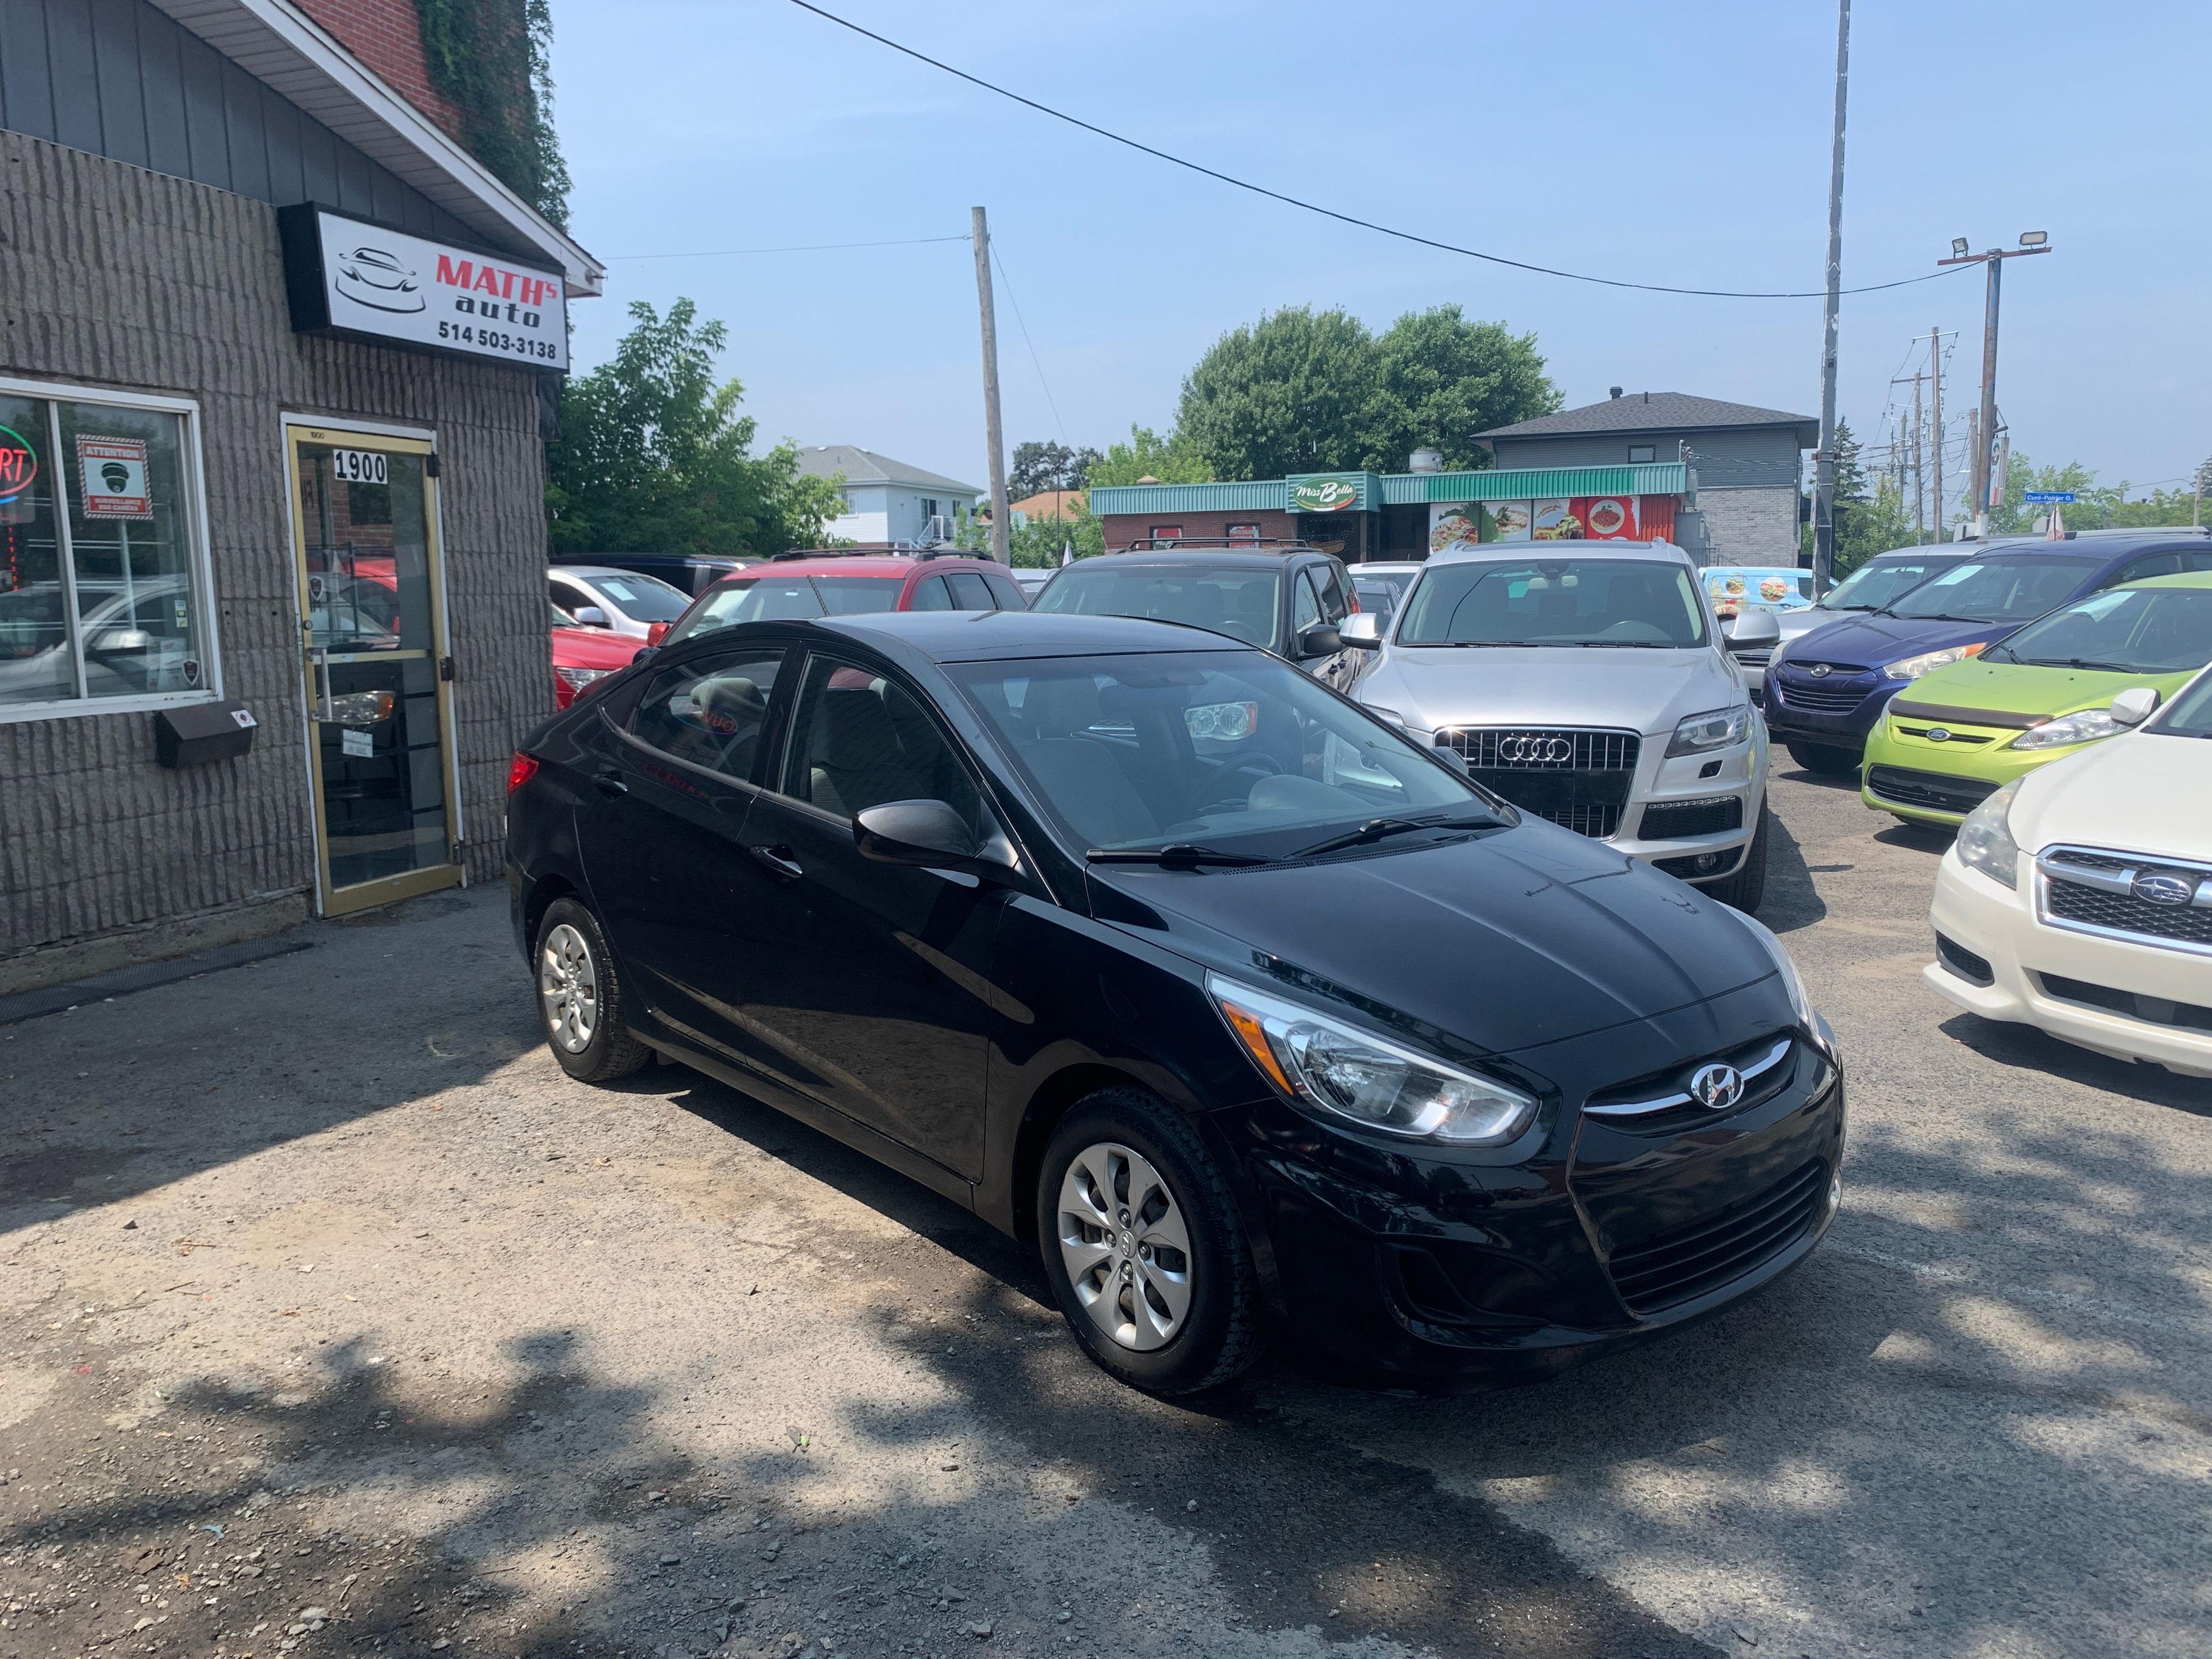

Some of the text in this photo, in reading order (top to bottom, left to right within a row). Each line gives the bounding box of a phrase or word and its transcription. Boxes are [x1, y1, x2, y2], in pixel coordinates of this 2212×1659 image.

[436, 253, 558, 306] MATH's
[456, 296, 540, 328] auto
[438, 321, 556, 359] 514 503-3138
[86, 446, 139, 459] ATTENTION
[336, 451, 385, 482] 1900
[1296, 482, 1353, 502] Miss Bella
